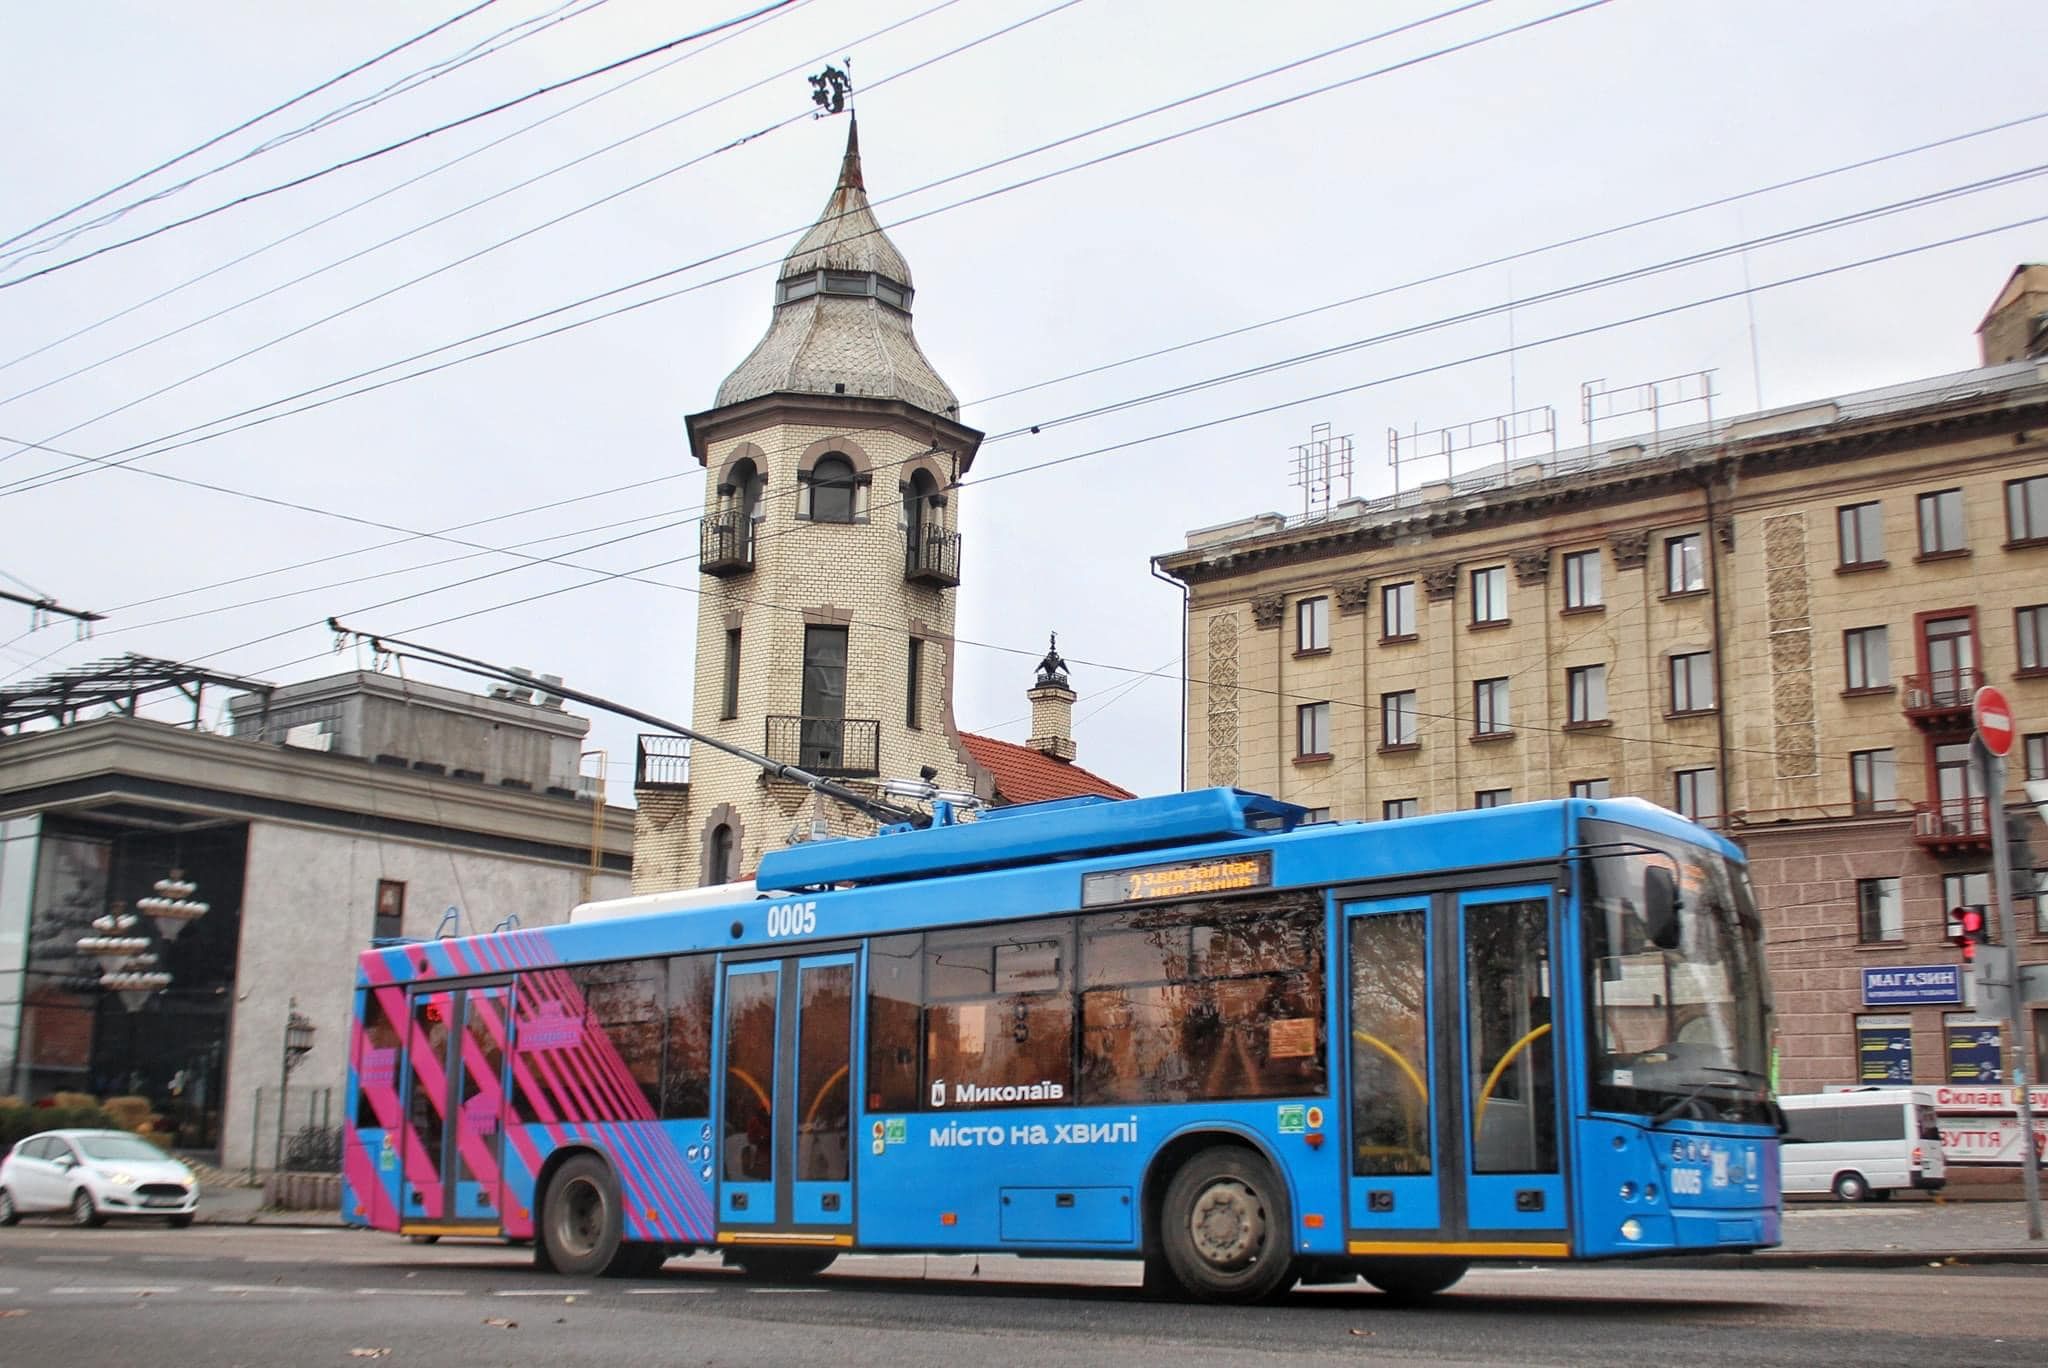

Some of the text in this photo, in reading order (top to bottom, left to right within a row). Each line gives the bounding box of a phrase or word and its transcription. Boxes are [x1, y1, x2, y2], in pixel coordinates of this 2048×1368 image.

[767, 901, 817, 938] 0005
[1866, 971, 1956, 989] МАГАЗИН
[955, 1081, 1064, 1103] Миколаїв
[1937, 1088, 2005, 1107] Склад
[929, 1120, 1005, 1147] місто
[1010, 1126, 1049, 1146] на
[1053, 1115, 1138, 1144] хвилі
